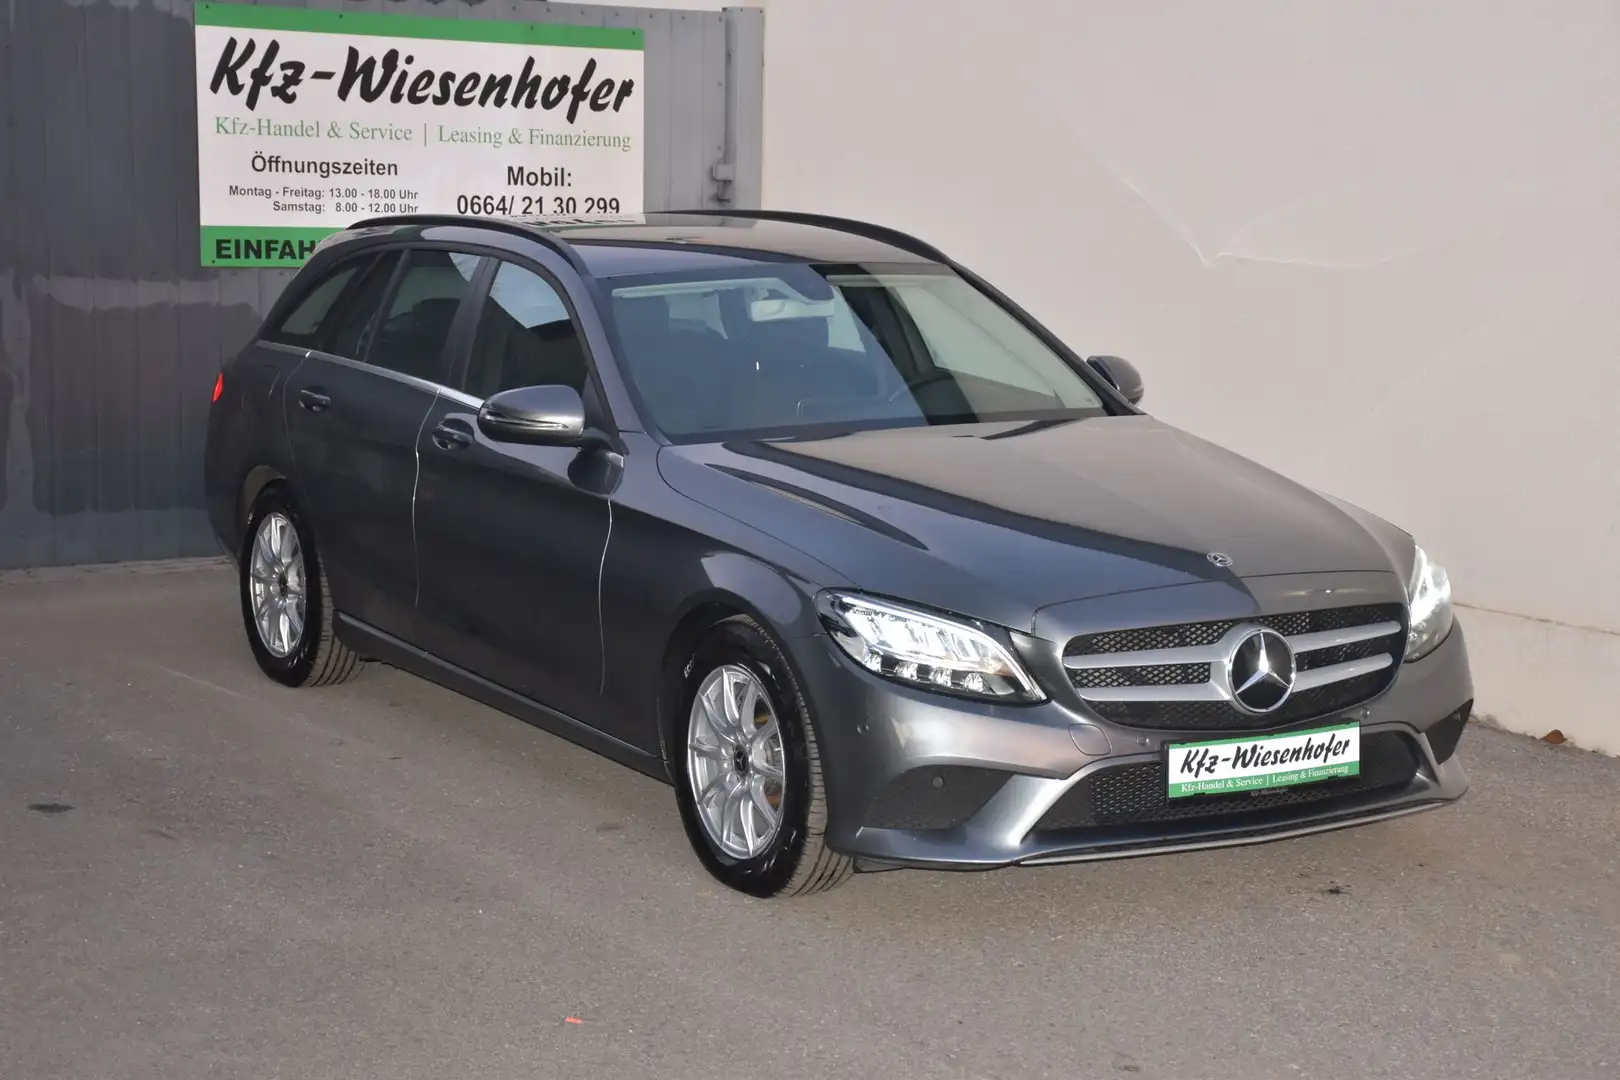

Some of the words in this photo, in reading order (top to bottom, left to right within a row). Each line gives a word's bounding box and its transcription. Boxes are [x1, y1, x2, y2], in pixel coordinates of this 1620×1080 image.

[209, 36, 635, 125] Kfz-Wiesenhofer
[215, 116, 320, 138] Kfz-Handel
[327, 121, 344, 138] &
[350, 121, 413, 141] Service
[437, 125, 503, 149] Leasing
[508, 127, 524, 145] &
[528, 128, 631, 153] Finanzierung
[251, 151, 398, 179] Öffnungszeiten
[507, 166, 572, 187] Mobil:
[229, 185, 272, 198] Montag
[282, 186, 325, 200] Freitag:
[329, 188, 358, 199] 13.00
[368, 189, 396, 199] 18.00
[399, 189, 418, 200] Uhr
[457, 195, 514, 216] 0664/
[521, 196, 545, 215] 21
[553, 197, 577, 214] 30
[585, 197, 620, 214] 299
[273, 201, 326, 215] Samstag:
[335, 202, 358, 213] 8.00
[368, 203, 396, 213] 12.00
[399, 204, 419, 214] Uhr
[1180, 733, 1350, 778] Kfz-Wiesenhofer
[1181, 780, 1225, 793] Kfz-Handel
[1226, 778, 1234, 788] &
[1235, 776, 1263, 787] Service
[1272, 771, 1298, 783] Leasing
[1300, 770, 1307, 779] &
[1308, 764, 1349, 778] Finanzierung
